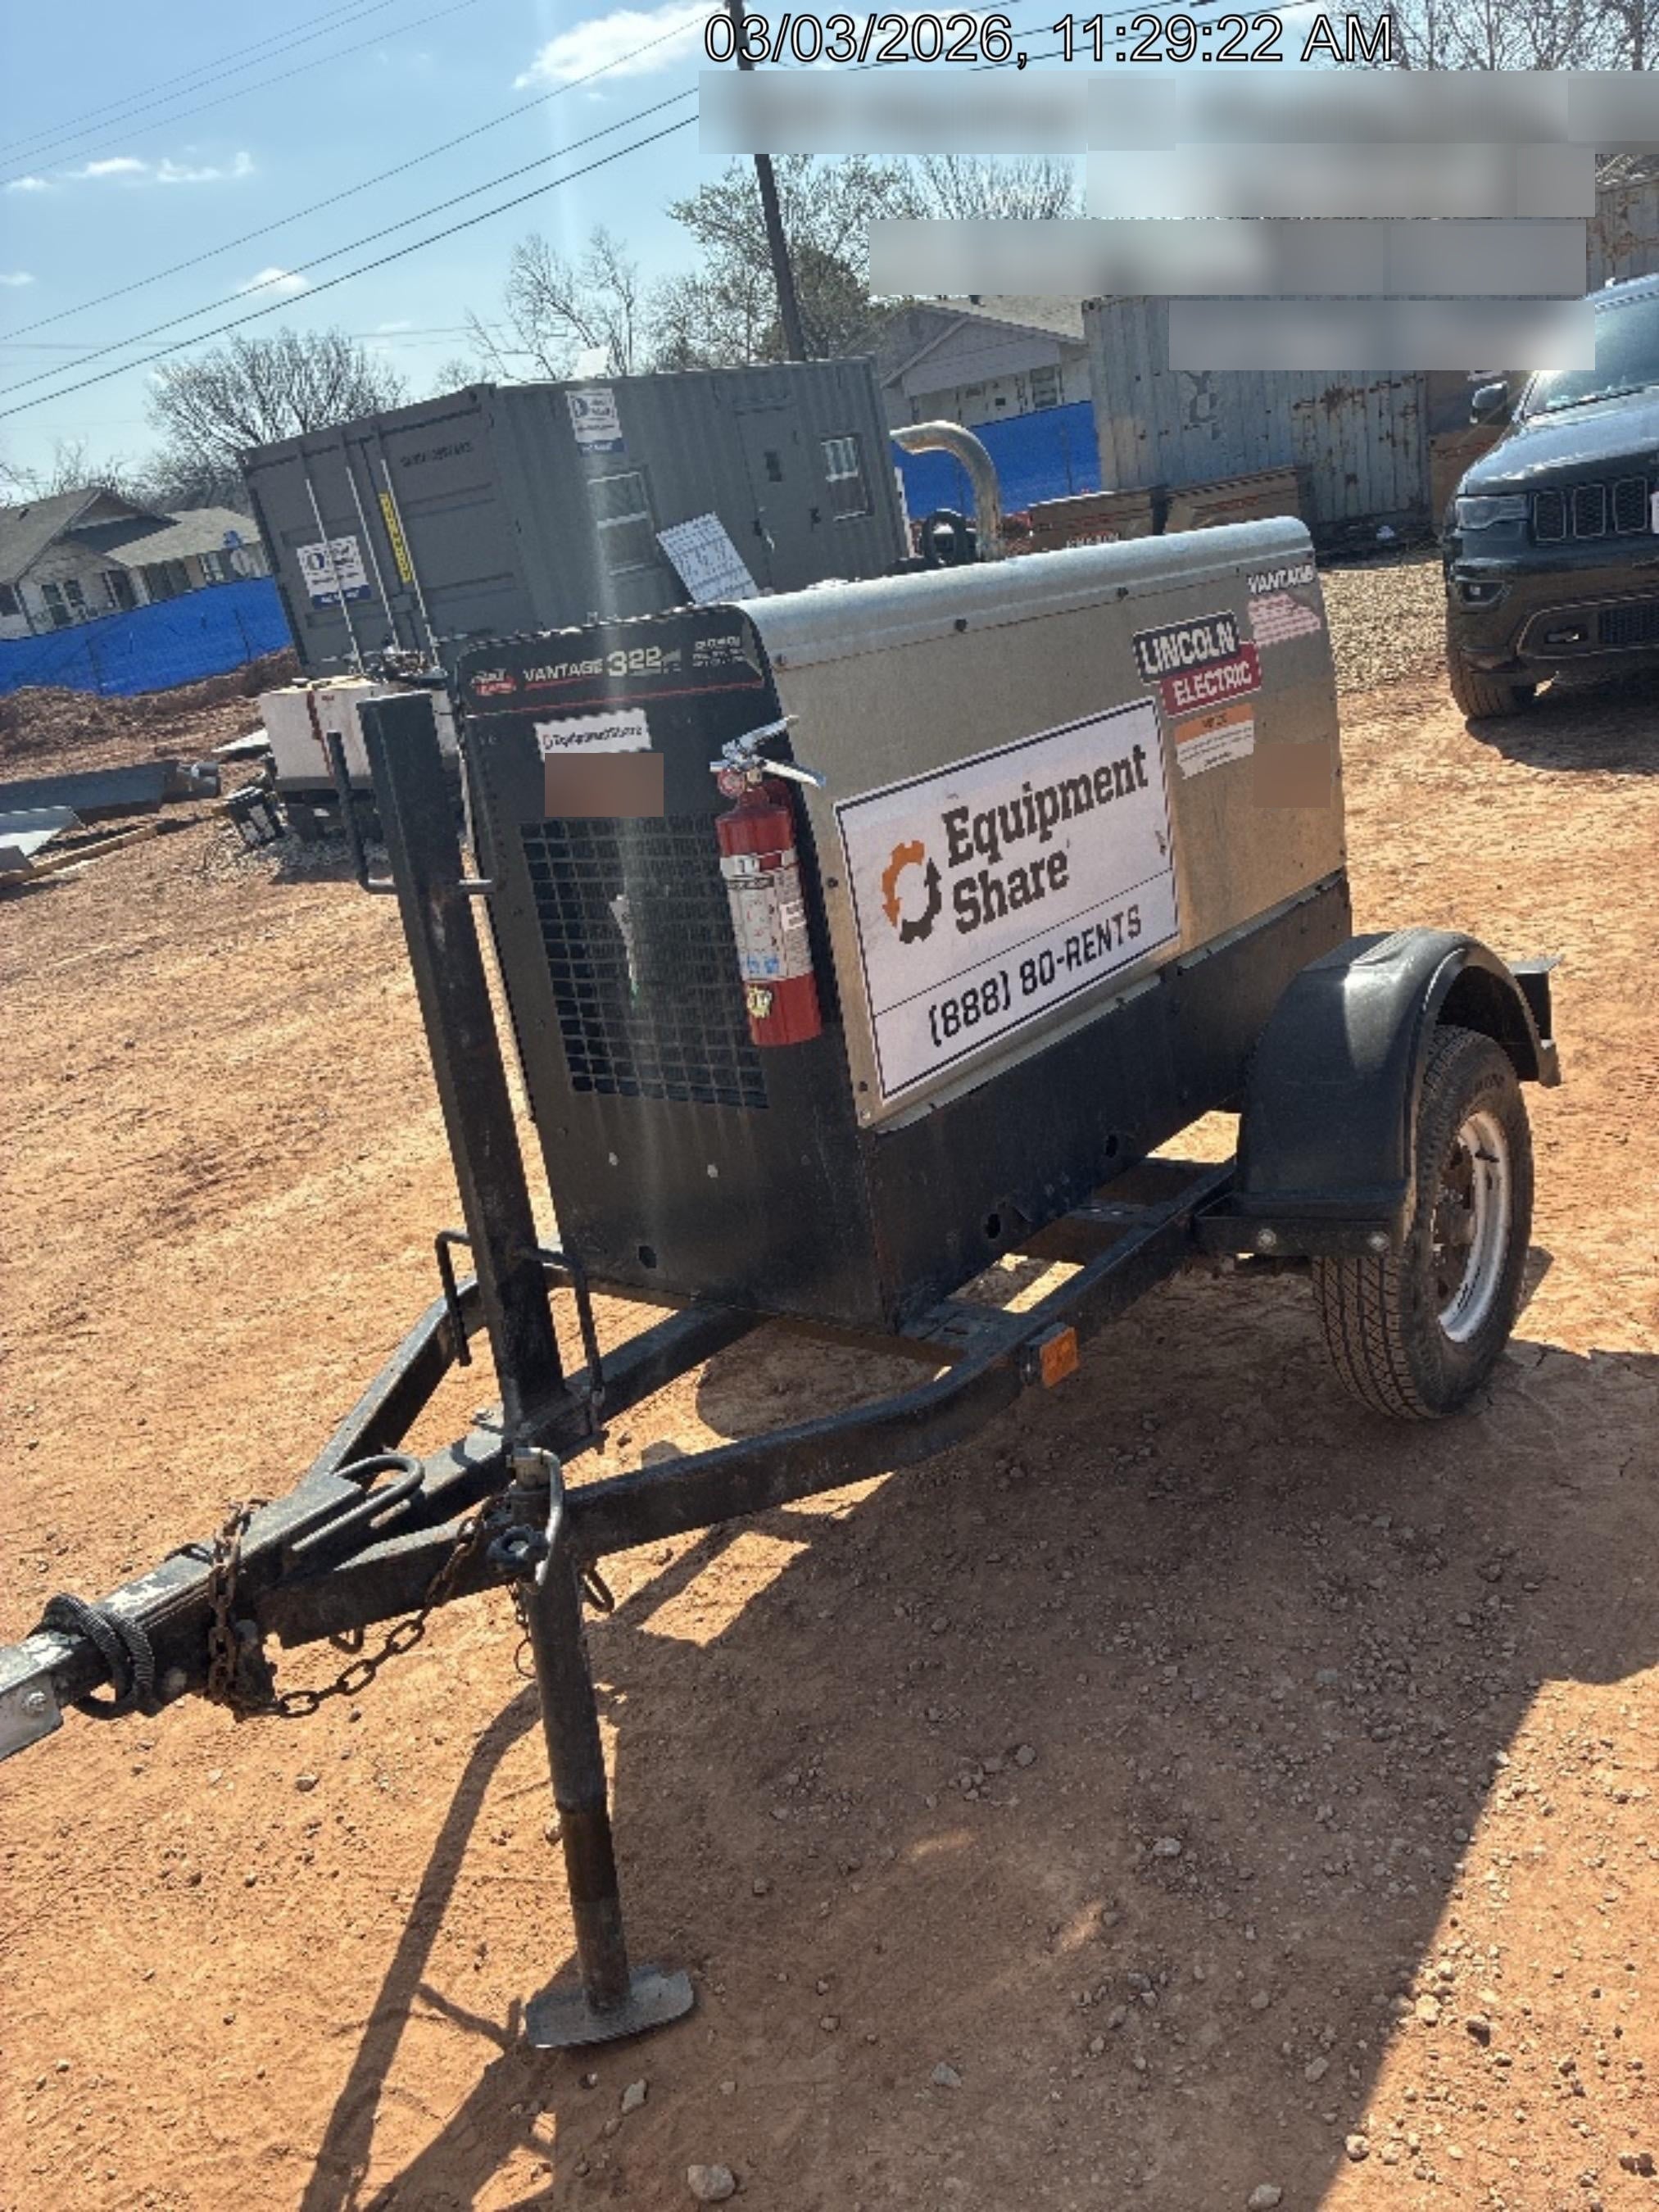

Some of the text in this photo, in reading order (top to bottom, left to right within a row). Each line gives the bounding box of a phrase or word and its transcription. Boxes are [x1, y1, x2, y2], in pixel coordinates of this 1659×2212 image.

[1248, 564, 1314, 594] VANTAGE
[523, 658, 604, 682] VANTAGE
[606, 646, 662, 678] 322
[1140, 620, 1236, 675] LINCOLN
[1172, 660, 1253, 706] ELECTRIC
[941, 743, 1149, 868] Equipment
[951, 849, 1070, 935] Share
[928, 904, 1142, 1048] (888) 80-RENTS
